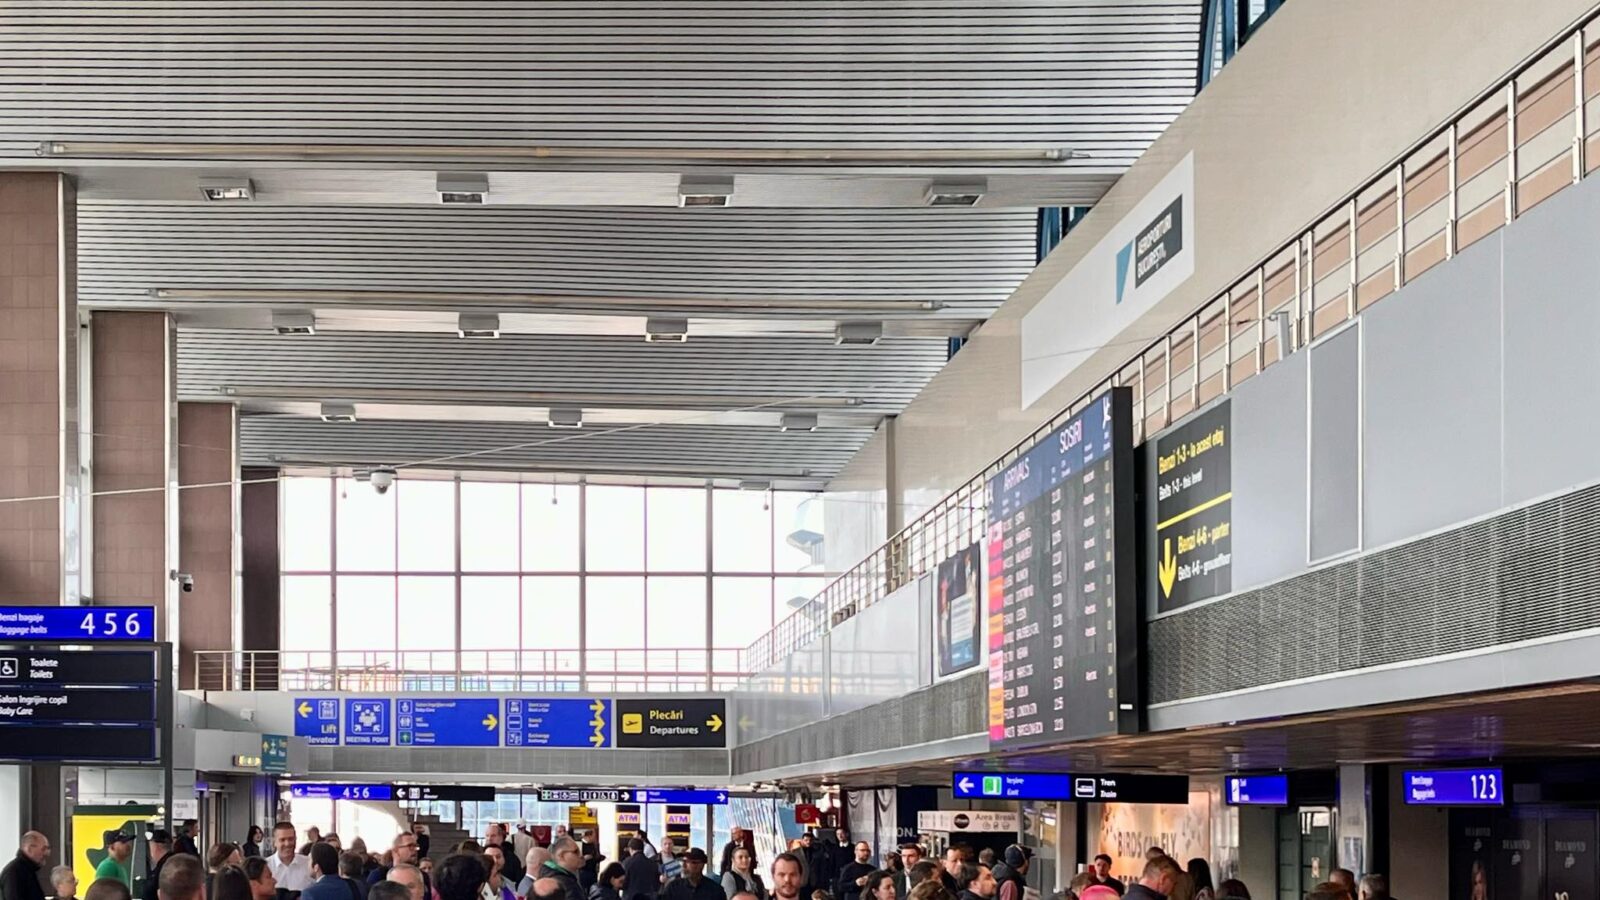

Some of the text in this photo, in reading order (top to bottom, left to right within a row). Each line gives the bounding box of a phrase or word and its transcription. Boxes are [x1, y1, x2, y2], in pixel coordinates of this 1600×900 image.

[1003, 457, 1030, 493] ARRIVALS
[18, 613, 45, 624] bagaje
[80, 612, 141, 636] 4 5 6
[30, 658, 59, 667] Toalete
[30, 669, 54, 679] Toilets
[48, 695, 68, 706] copil
[16, 706, 34, 715] Care
[649, 709, 684, 720] Plecări
[321, 724, 337, 734] Lift
[649, 725, 699, 737] Departures
[1100, 778, 1116, 787] Tren
[342, 787, 350, 798] 4
[353, 787, 360, 798] 5
[362, 787, 370, 799] 6
[1100, 789, 1118, 798] Train
[618, 814, 639, 823] ATM
[668, 815, 689, 823] ATM
[975, 813, 993, 821] Area
[995, 813, 1016, 821] Break
[1118, 831, 1142, 858] BIRDS
